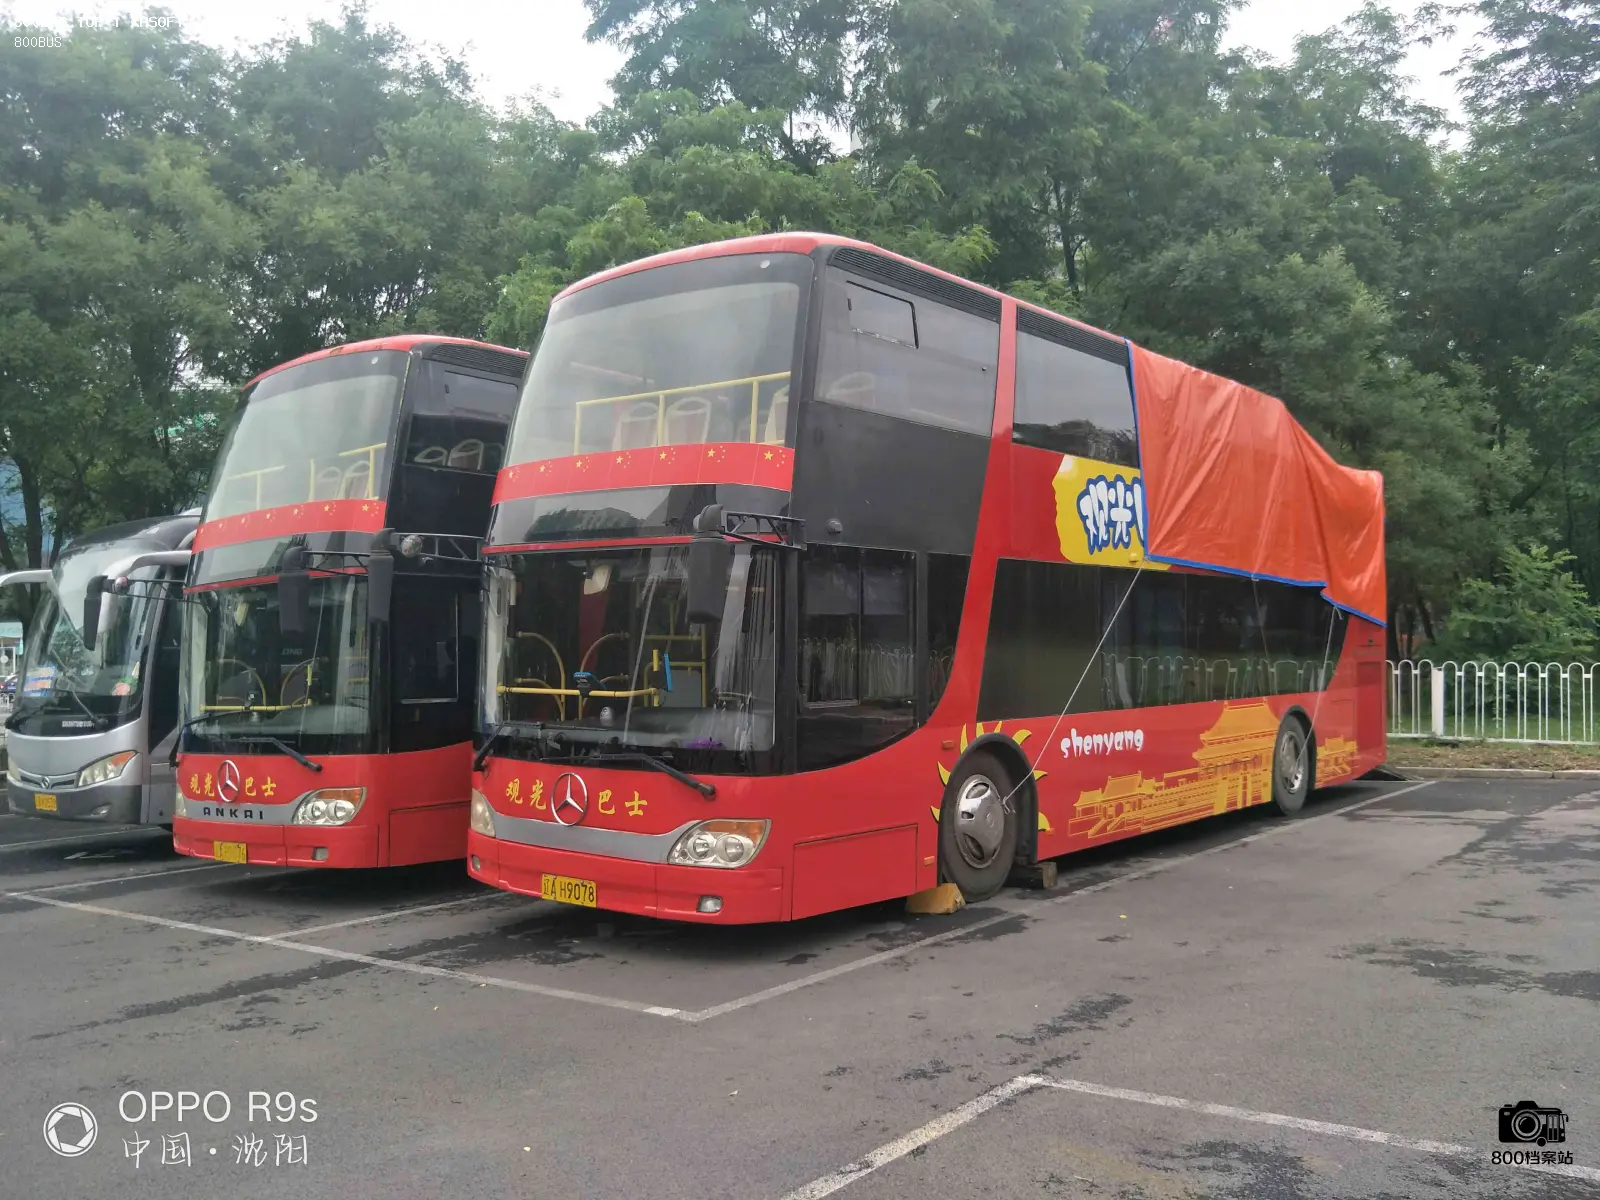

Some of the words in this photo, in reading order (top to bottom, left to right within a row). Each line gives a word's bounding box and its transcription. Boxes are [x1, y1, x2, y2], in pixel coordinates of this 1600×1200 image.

[1060, 727, 1144, 759] shenyang
[244, 776, 277, 797] 巴士
[505, 777, 547, 811] 观光
[597, 789, 648, 817] 巴士
[202, 806, 264, 820] ANKAI
